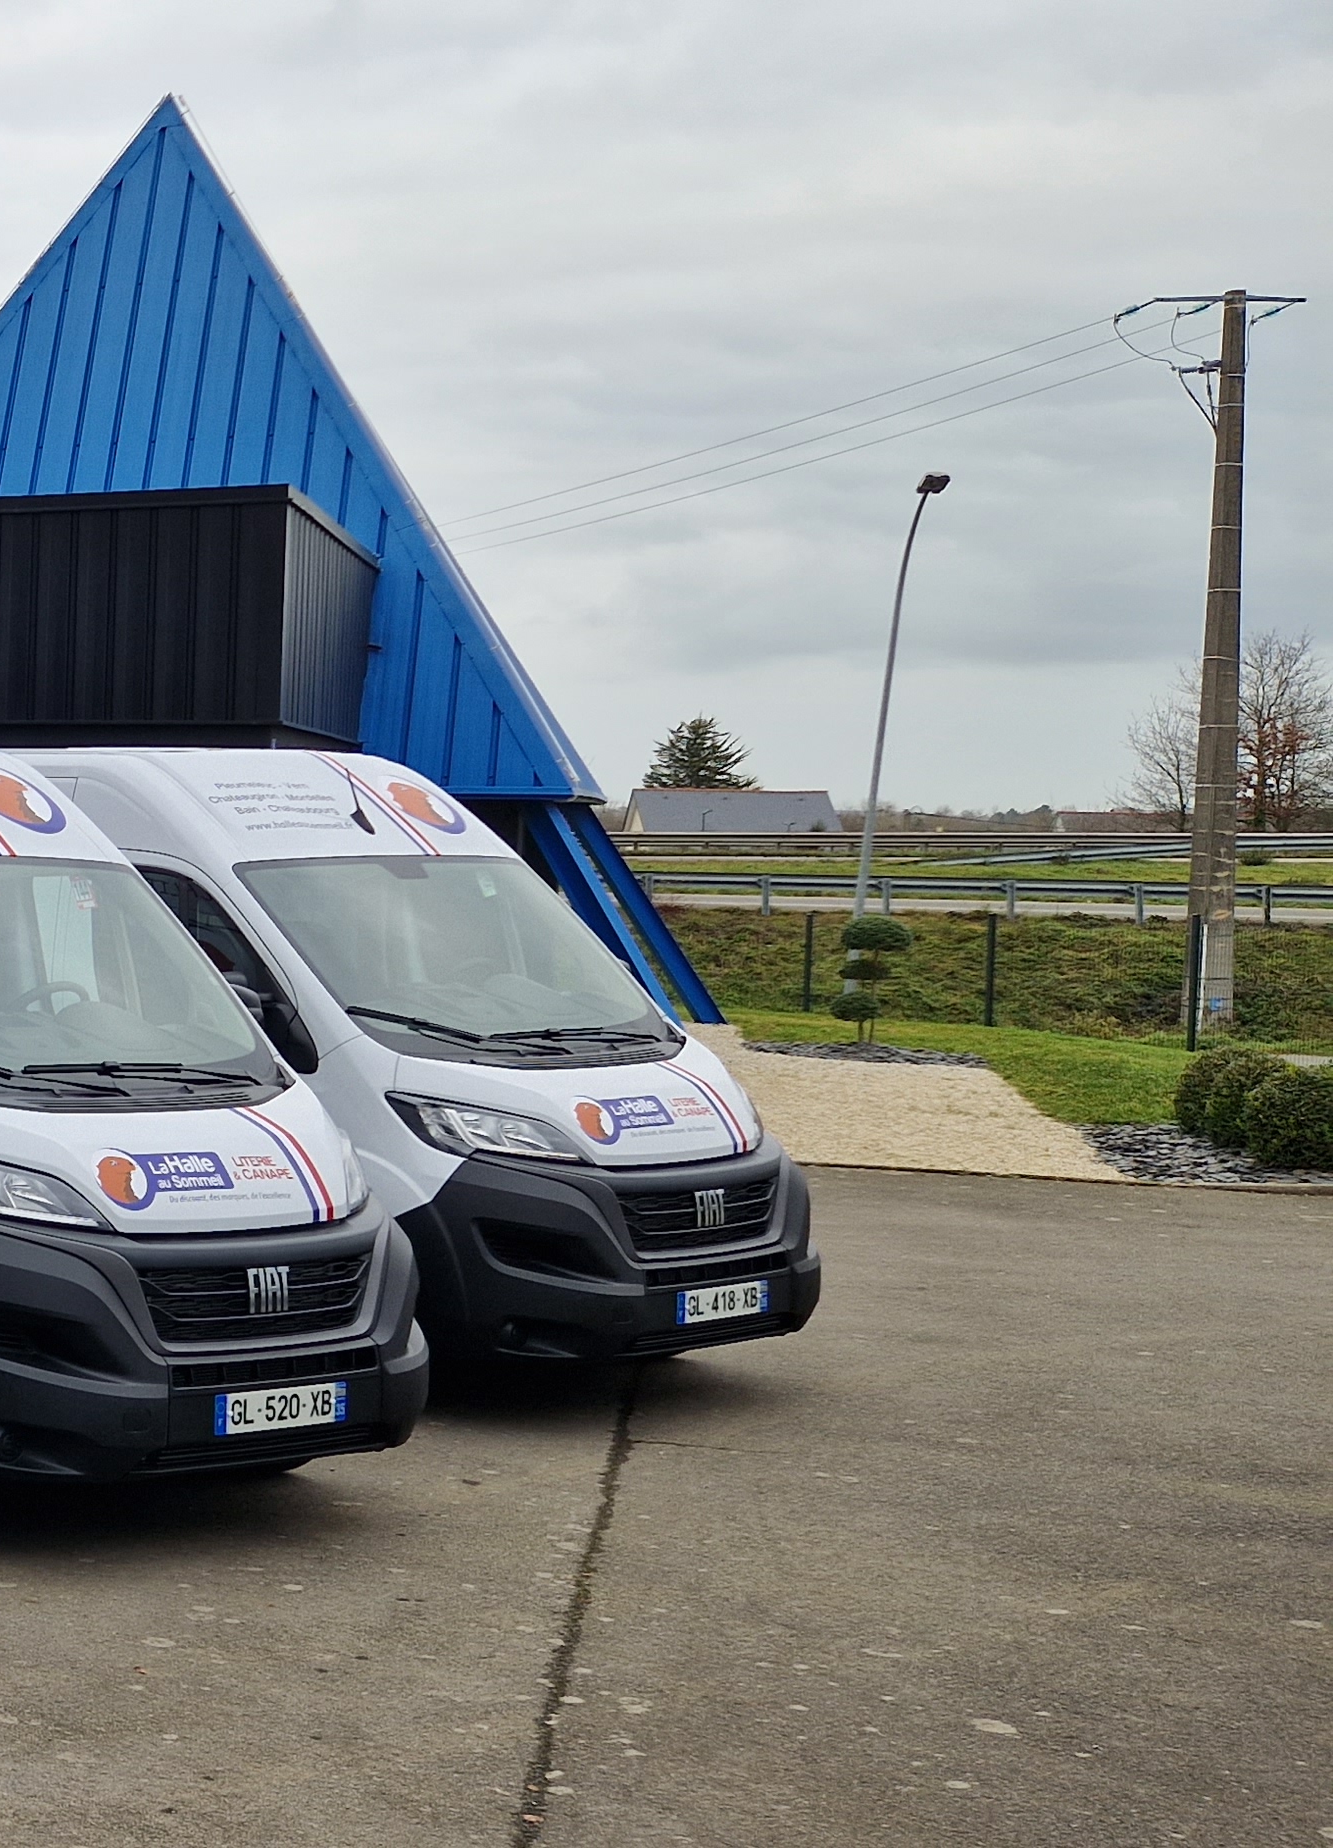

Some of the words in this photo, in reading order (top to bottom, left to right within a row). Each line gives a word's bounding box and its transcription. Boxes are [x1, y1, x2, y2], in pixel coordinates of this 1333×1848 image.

[166, 1155, 216, 1174] Halle
[232, 1156, 277, 1167] LITERIE
[157, 1178, 171, 1189] au
[171, 1173, 226, 1189] Sommeil
[695, 1189, 725, 1228] FIAT
[247, 1266, 290, 1314] FIAT
